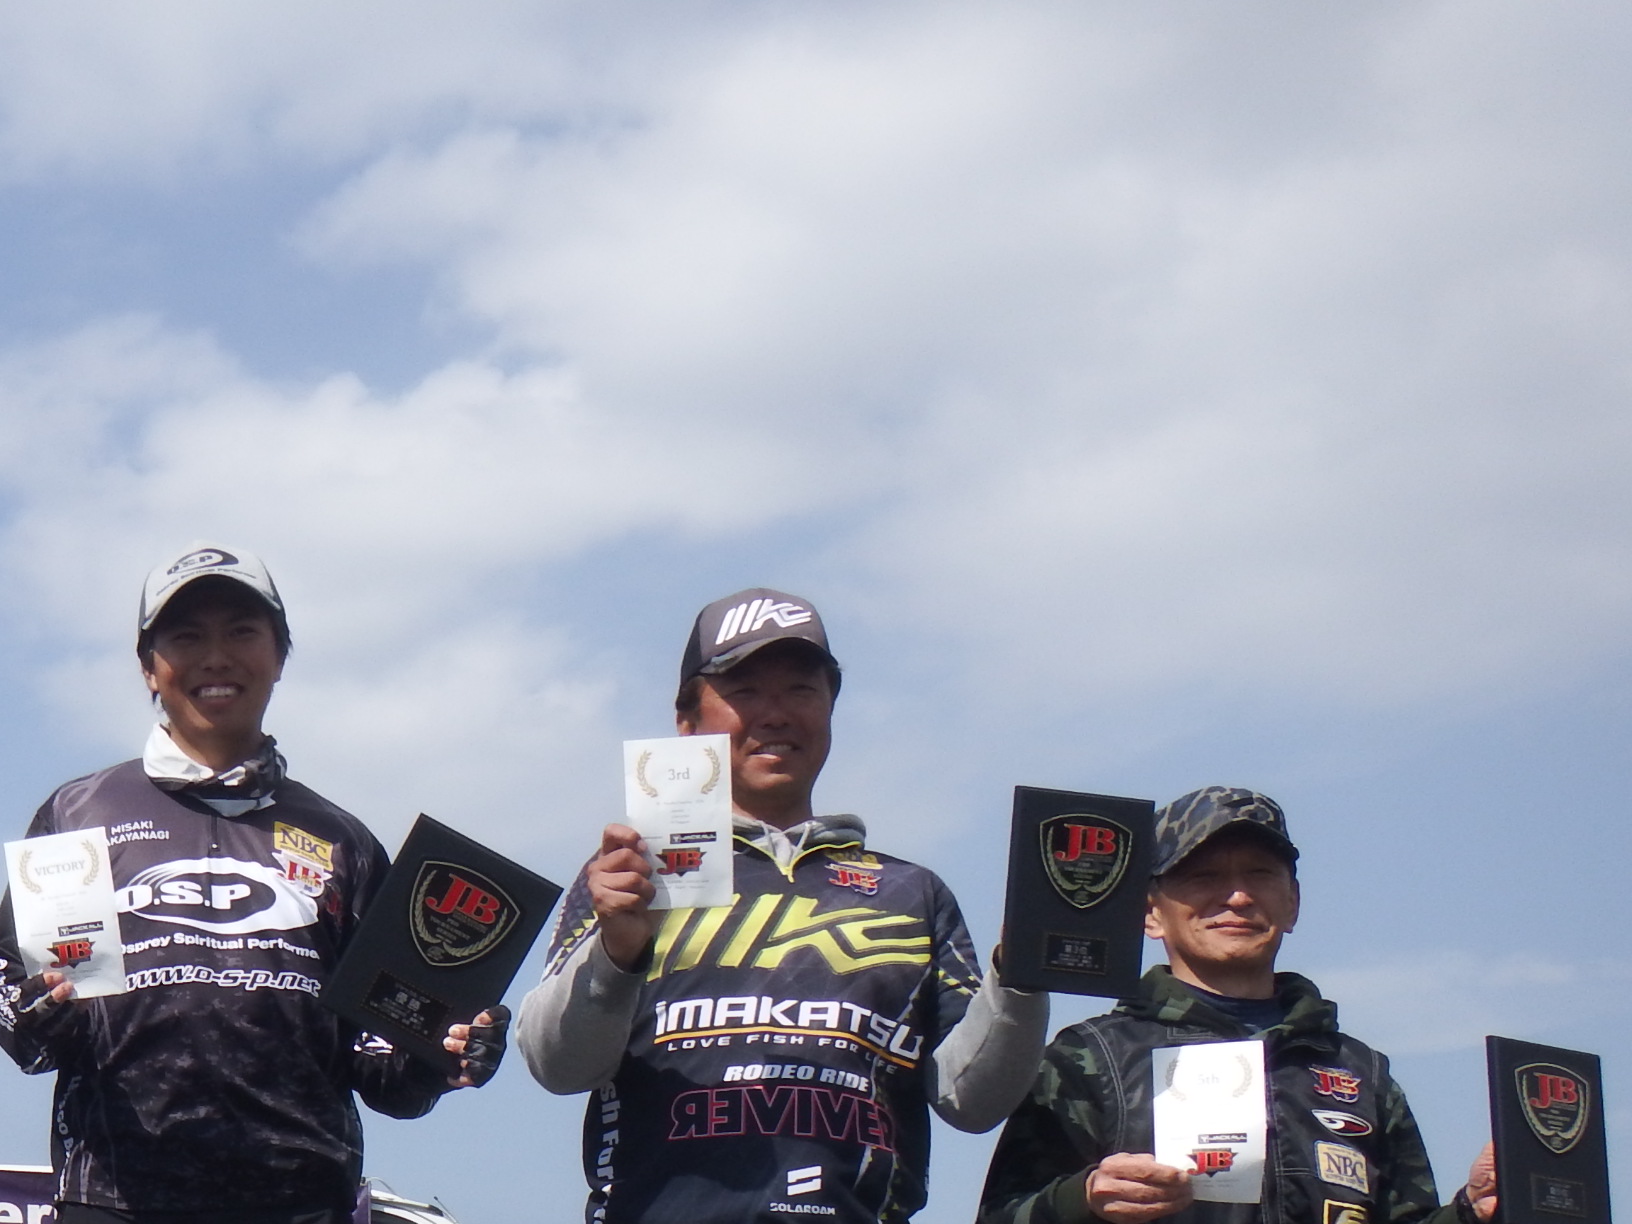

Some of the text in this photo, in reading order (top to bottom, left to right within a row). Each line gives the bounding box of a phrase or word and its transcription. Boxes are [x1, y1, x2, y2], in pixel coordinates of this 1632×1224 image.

[668, 768, 691, 781] 3rd
[111, 820, 154, 835] MISAKI
[280, 827, 329, 862] NBC
[1052, 823, 1117, 862] JB
[34, 860, 86, 877] VICTORY
[656, 851, 703, 876] JB
[425, 872, 501, 925] JB
[50, 940, 93, 969] JB
[173, 932, 244, 950] Spiritual
[667, 1034, 899, 1075] LOVE FISH FOR LFE
[723, 1063, 870, 1093] RODEO RIDE
[1529, 1072, 1579, 1110] JB
[1186, 1151, 1234, 1176] JB
[1323, 1151, 1365, 1185] NBC
[769, 1202, 836, 1216] SOLAROAM
